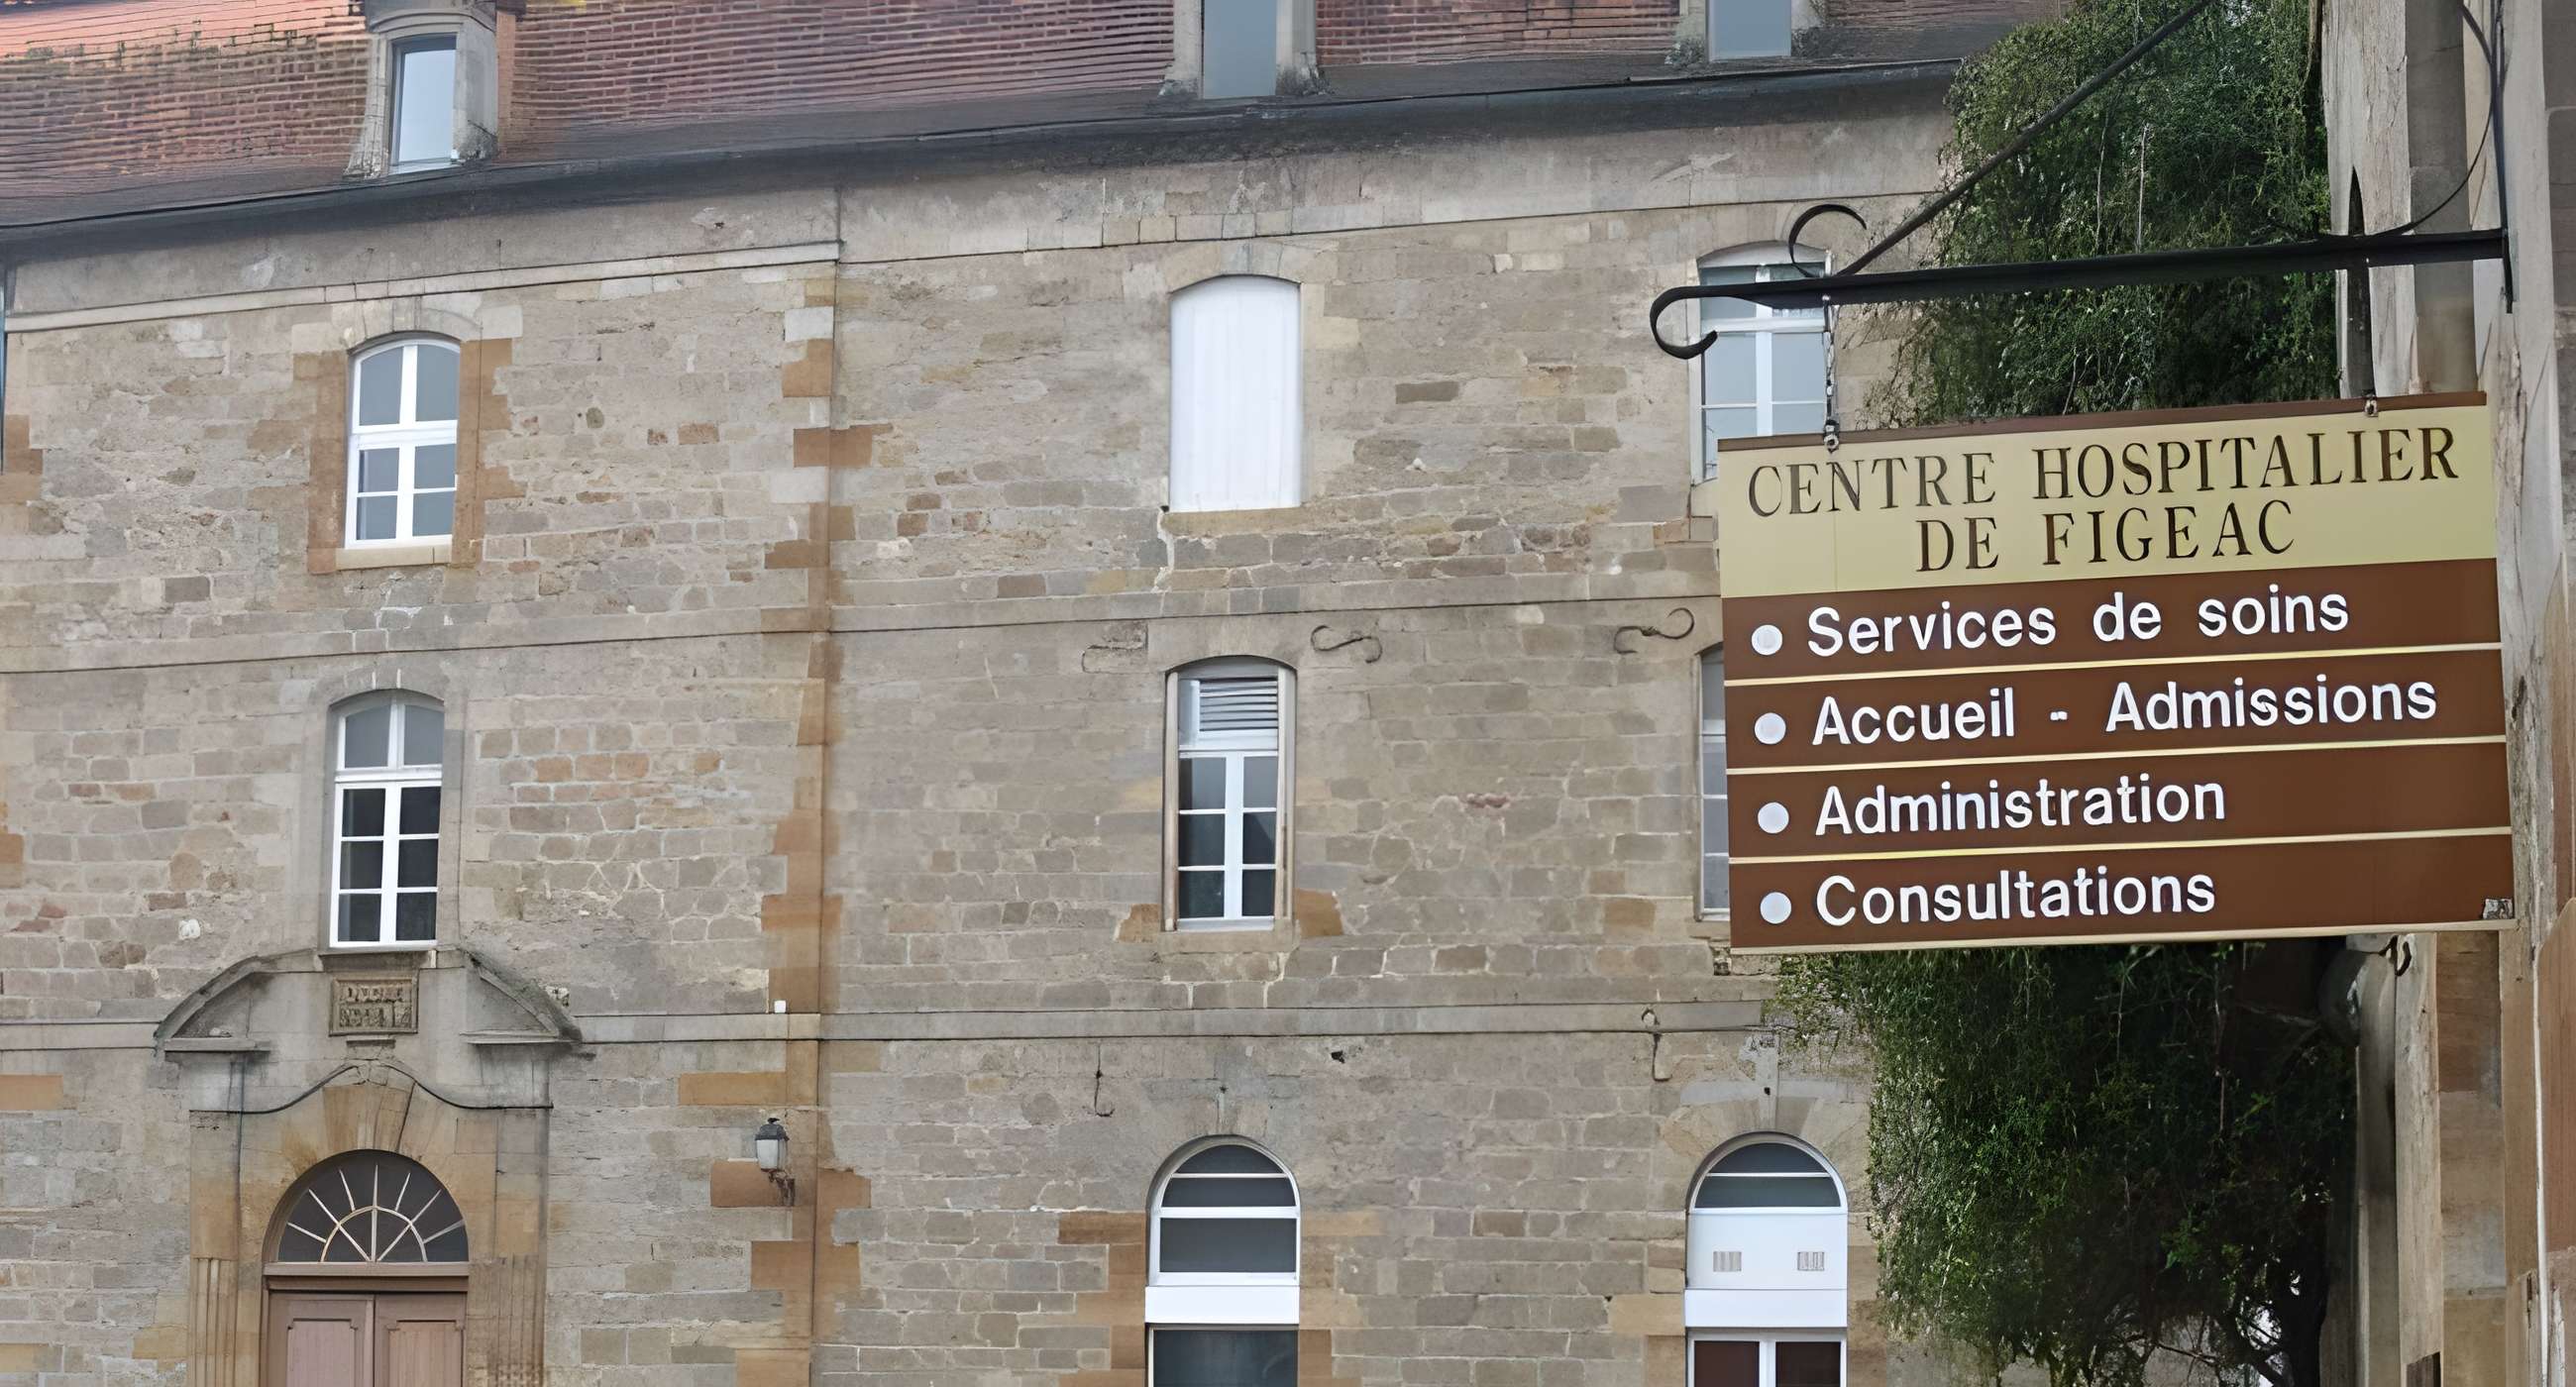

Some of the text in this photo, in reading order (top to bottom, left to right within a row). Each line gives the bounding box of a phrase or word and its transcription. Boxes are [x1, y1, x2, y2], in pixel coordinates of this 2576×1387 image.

[1748, 426, 2459, 517] CENTRE HOSPITALIER
[1916, 499, 2295, 572] DE FIGEAC
[1808, 584, 2348, 656] Services de soins
[1812, 688, 2014, 745] Accueil
[2106, 674, 2436, 731] Admissions
[1815, 773, 2225, 836] Administration
[1817, 866, 2214, 925] Consultations
